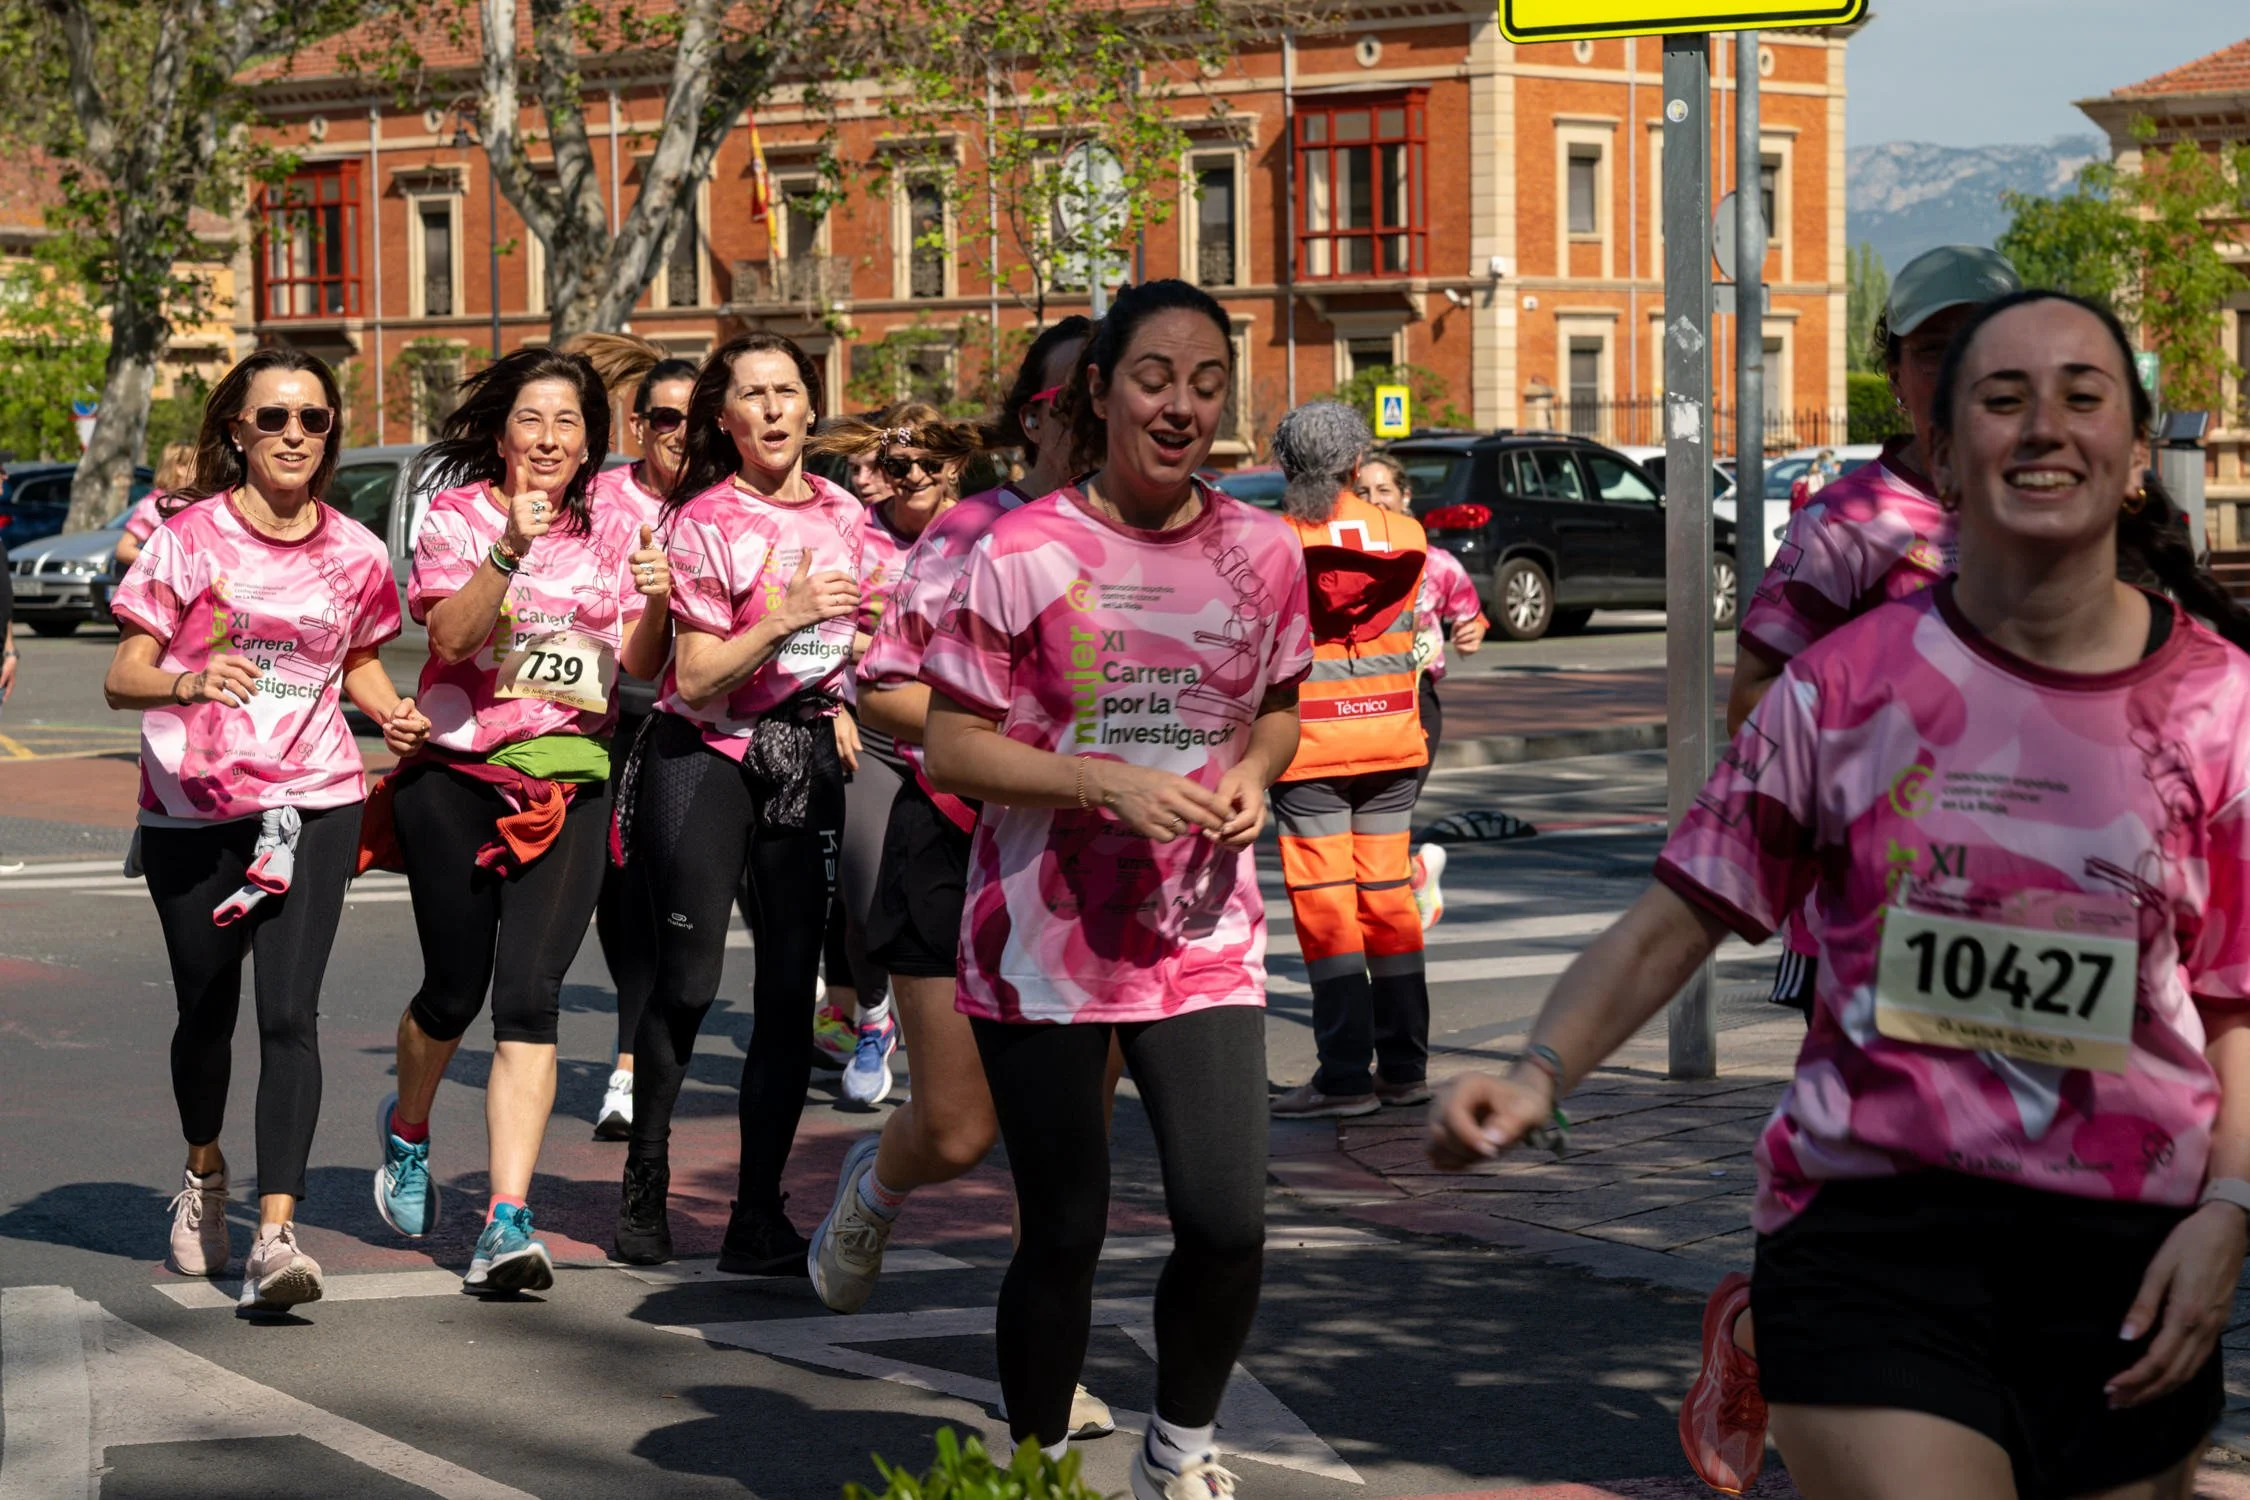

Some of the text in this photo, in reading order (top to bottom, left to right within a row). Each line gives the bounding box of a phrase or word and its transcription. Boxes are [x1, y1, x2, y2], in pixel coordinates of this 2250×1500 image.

[514, 586, 533, 602] XI
[231, 612, 250, 629] XI
[231, 634, 294, 653] Carrera
[1101, 630, 1125, 652] XI
[527, 650, 584, 686] 739
[1102, 661, 1198, 684] Carrera
[1064, 625, 1105, 744] mujer
[1103, 692, 1171, 718] por la
[1334, 698, 1388, 716] Técnico
[1930, 843, 1967, 878] XI
[1906, 930, 2114, 1020] 10427
